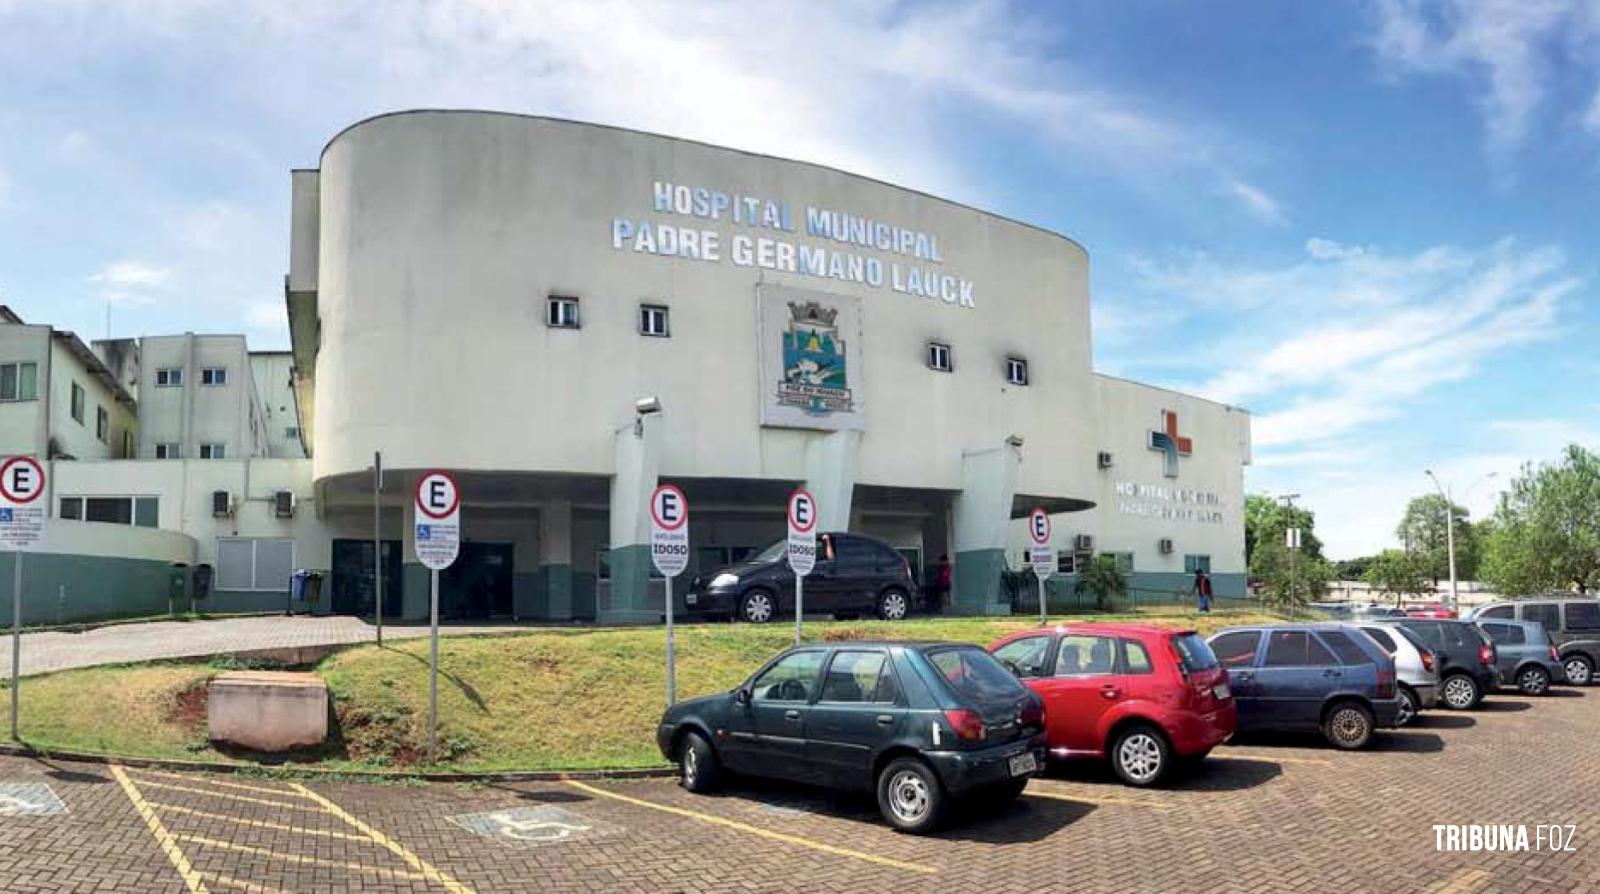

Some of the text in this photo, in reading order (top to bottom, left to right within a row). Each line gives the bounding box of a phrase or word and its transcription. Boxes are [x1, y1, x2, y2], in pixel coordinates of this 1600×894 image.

[653, 181, 944, 262] HOSPITAL MUNICIPAL
[612, 218, 975, 308] PADRE GERMANO LAUCK
[13, 468, 30, 492] E
[430, 481, 446, 508] E
[662, 494, 677, 521] E
[796, 498, 808, 523] E
[1035, 515, 1045, 536] E
[653, 544, 688, 555] IDOSO
[789, 543, 815, 556] IDOSO
